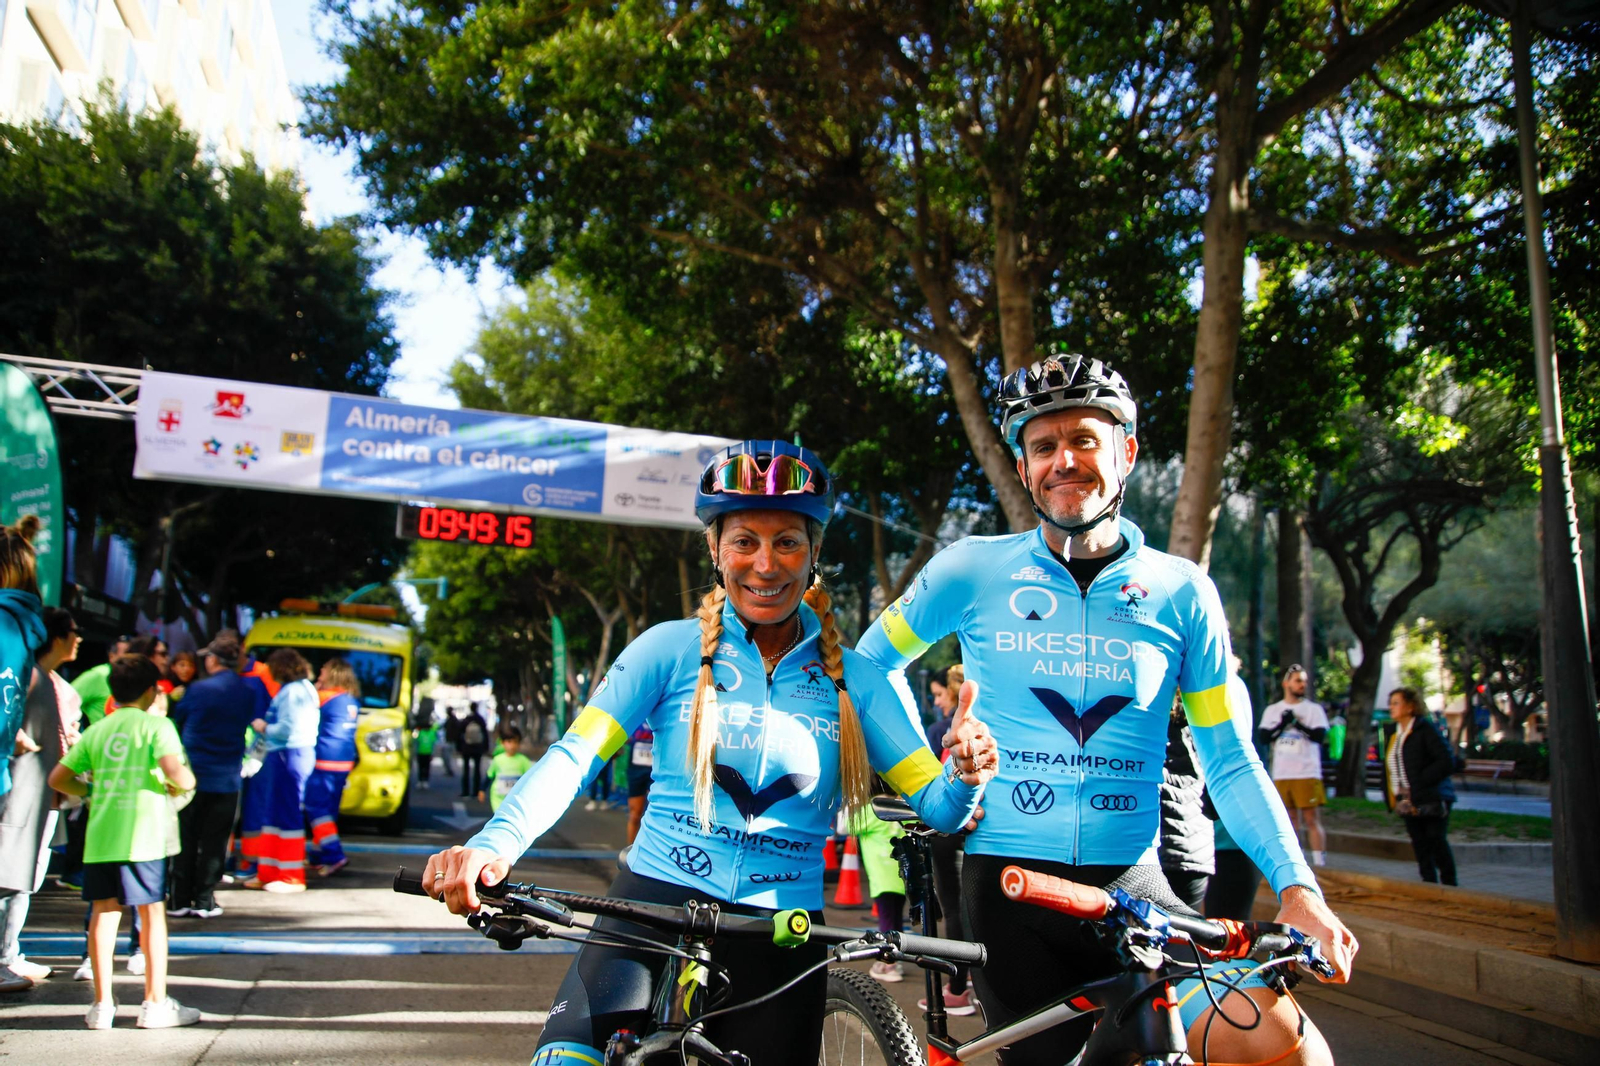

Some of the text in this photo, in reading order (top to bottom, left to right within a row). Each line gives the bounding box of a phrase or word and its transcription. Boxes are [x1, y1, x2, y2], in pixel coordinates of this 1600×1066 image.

[345, 405, 450, 437] Almería
[342, 438, 431, 464] contra
[437, 444, 463, 467] el
[469, 446, 561, 476] cáncer
[1032, 659, 1134, 684] ALMERÍA
[1005, 749, 1147, 774] VERAIMPORT
[1005, 763, 1048, 772] GRUPO
